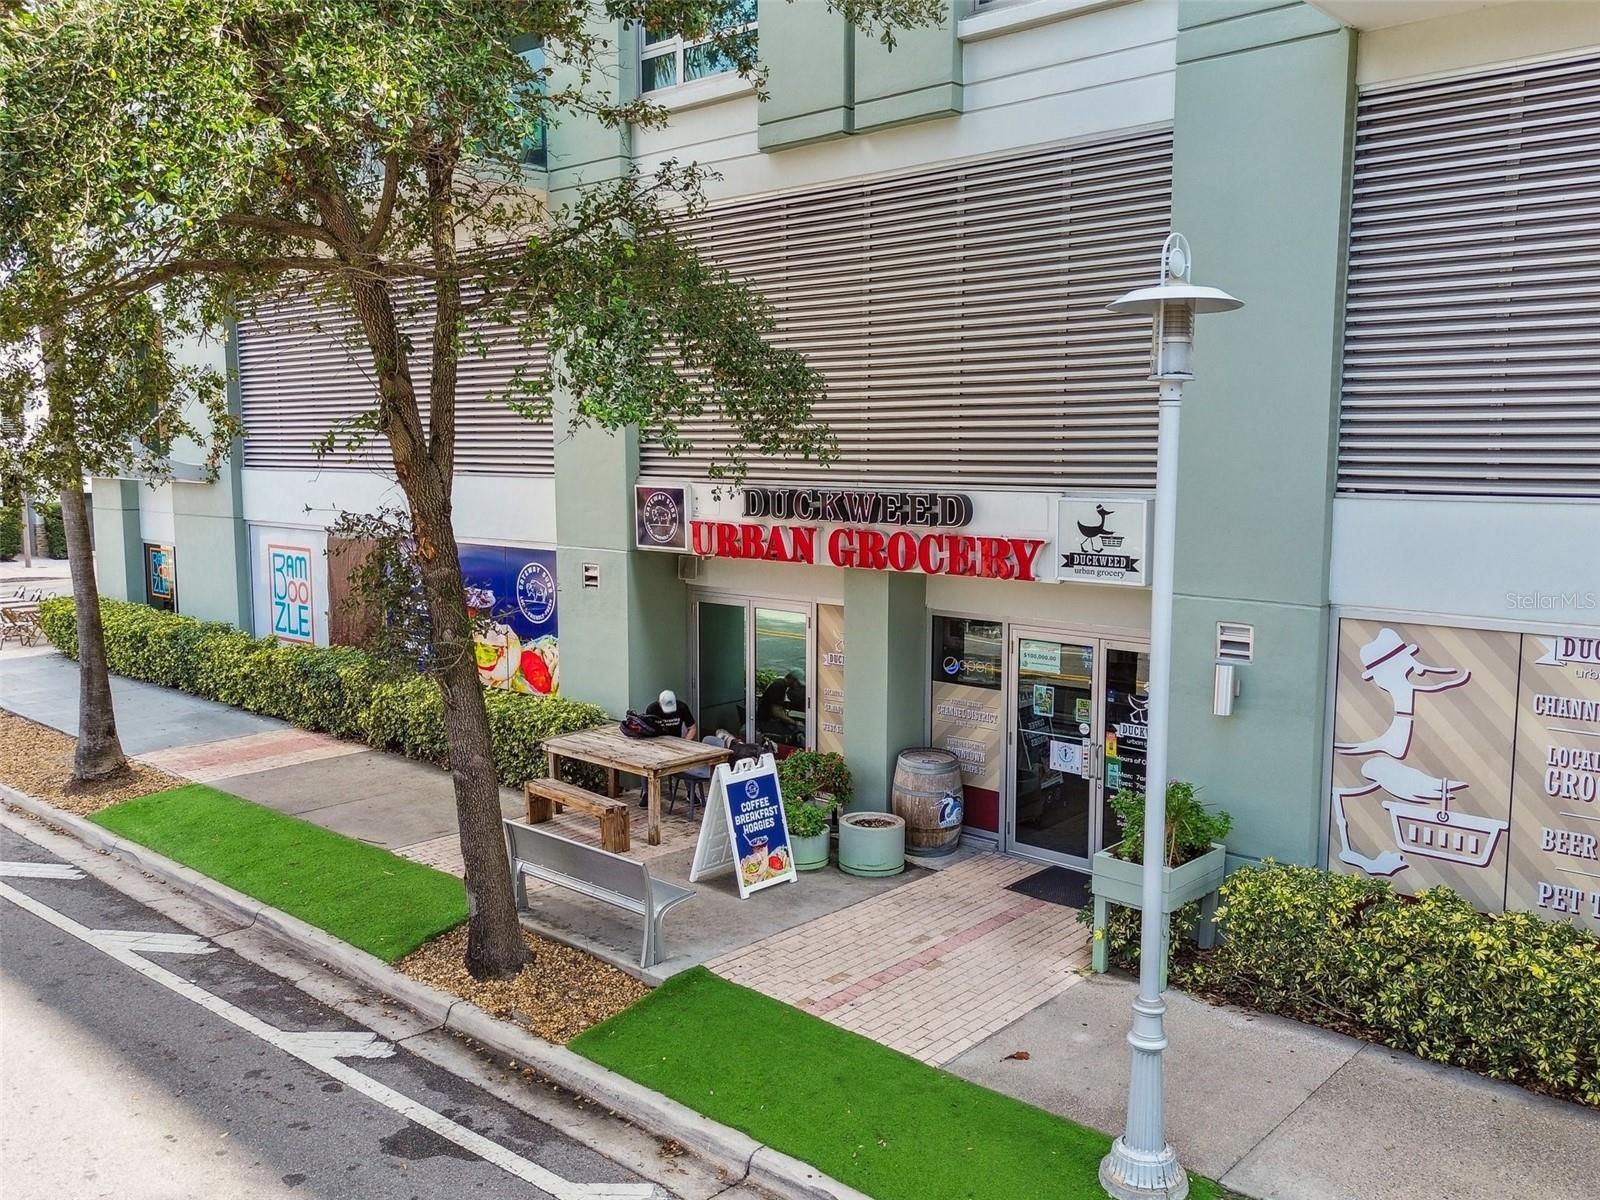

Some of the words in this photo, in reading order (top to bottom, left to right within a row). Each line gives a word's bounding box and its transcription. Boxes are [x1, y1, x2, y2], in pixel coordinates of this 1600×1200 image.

[742, 488, 973, 528] DUCKWEED
[690, 521, 817, 564] URBAN
[828, 527, 1046, 581] GROCERY
[1073, 554, 1127, 568] DUCKWEED
[1074, 567, 1096, 576] urban
[1097, 569, 1126, 579] grocery
[959, 659, 995, 676] open
[1115, 754, 1133, 764] Hours
[740, 796, 770, 813] COFFEE
[735, 805, 778, 826] BREAKFAST
[743, 817, 775, 835] HOAGIES
[1540, 826, 1599, 861] BEER
[1537, 880, 1585, 915] PET
